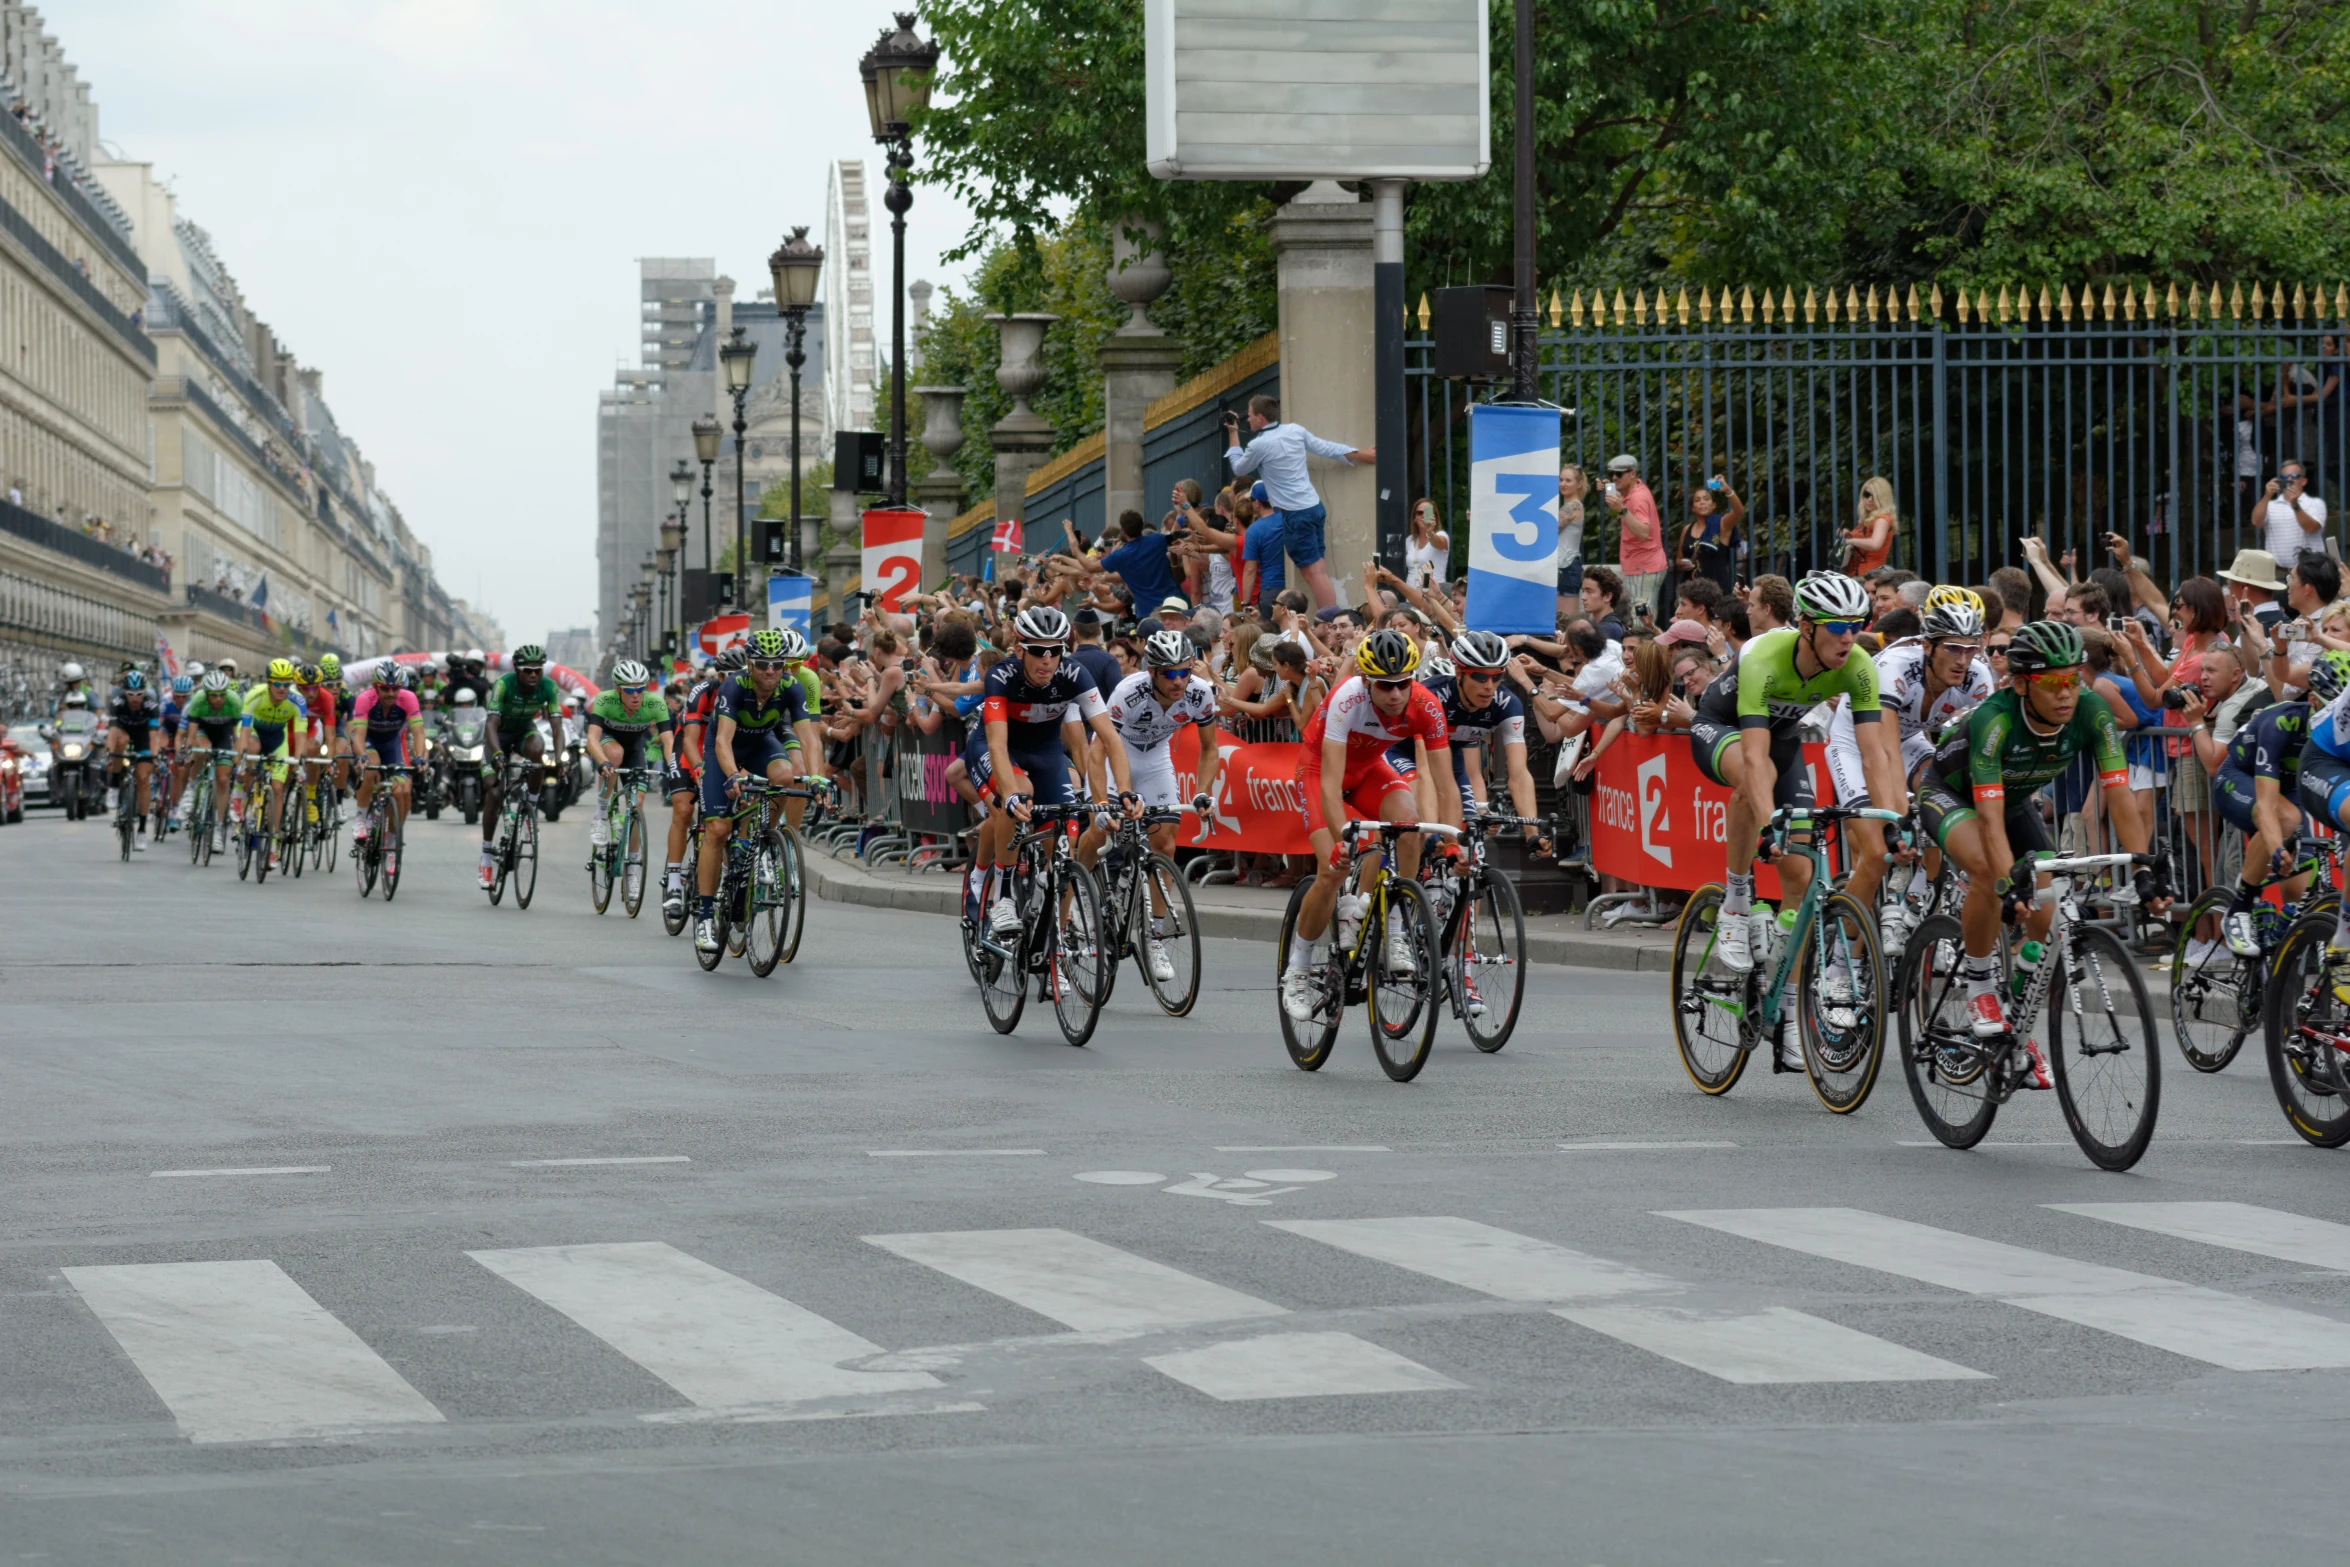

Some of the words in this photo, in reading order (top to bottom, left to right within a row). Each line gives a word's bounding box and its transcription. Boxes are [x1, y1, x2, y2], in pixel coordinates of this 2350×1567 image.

[1491, 473, 1559, 562] 3
[877, 556, 921, 614] 2
[991, 663, 1018, 685] IAM
[1054, 662, 1081, 682] AM
[1857, 668, 1872, 703] wemo
[688, 681, 710, 703] BMC
[1338, 692, 1366, 713] Cofidis
[1493, 690, 1511, 710] AM
[1424, 701, 1446, 738] Cofidis
[900, 740, 958, 816] ancetvsport
[1246, 766, 1302, 812] franc
[1831, 748, 1850, 793] BRETAGNE
[1461, 784, 1478, 814] IAM
[1597, 772, 1635, 832] france
[1981, 789, 2005, 798] som
[1693, 786, 1727, 843] fra
[1769, 956, 1789, 999] Bianchi
[2024, 966, 2052, 1034] COLNAGO
[2314, 1033, 2335, 1045] S3
